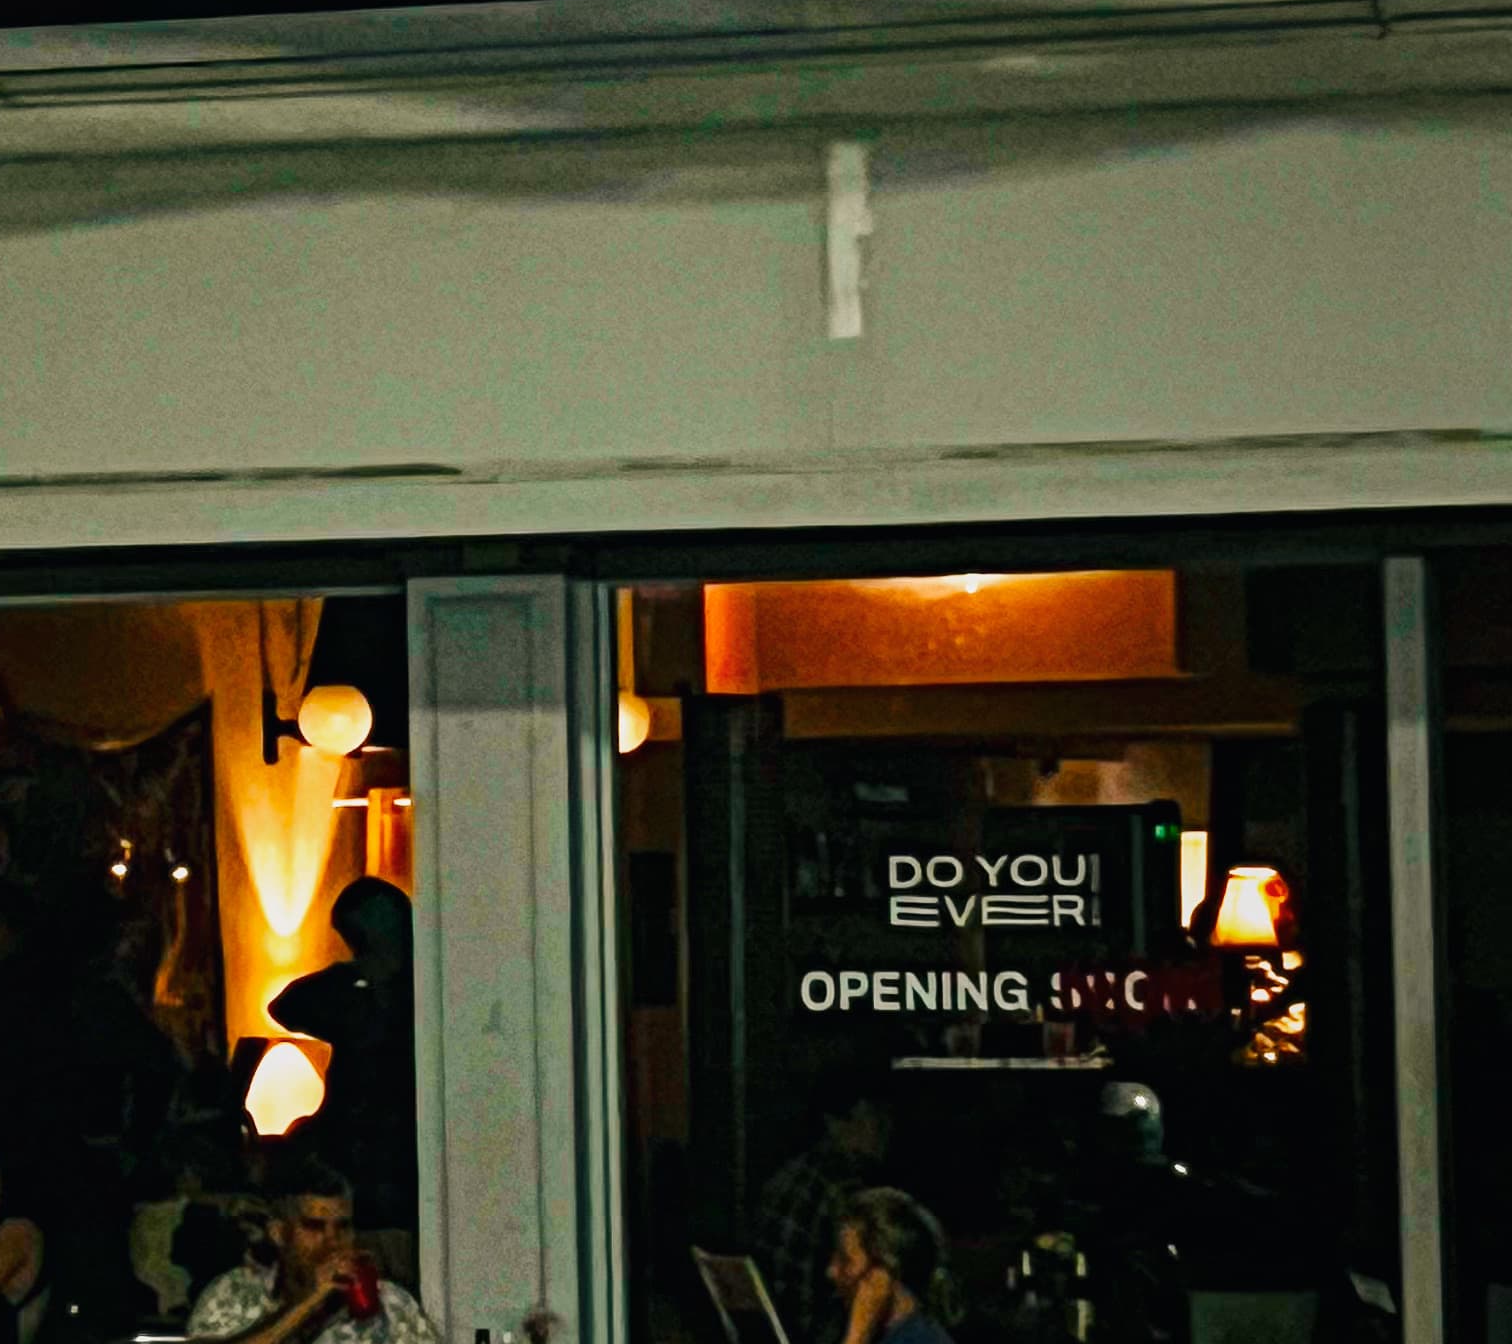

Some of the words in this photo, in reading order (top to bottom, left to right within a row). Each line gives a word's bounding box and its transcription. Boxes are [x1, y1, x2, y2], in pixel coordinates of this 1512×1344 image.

[888, 855, 963, 889] DO
[974, 854, 1086, 887] YOU
[889, 894, 1086, 928] EVER
[800, 970, 1030, 1012] OPENING
